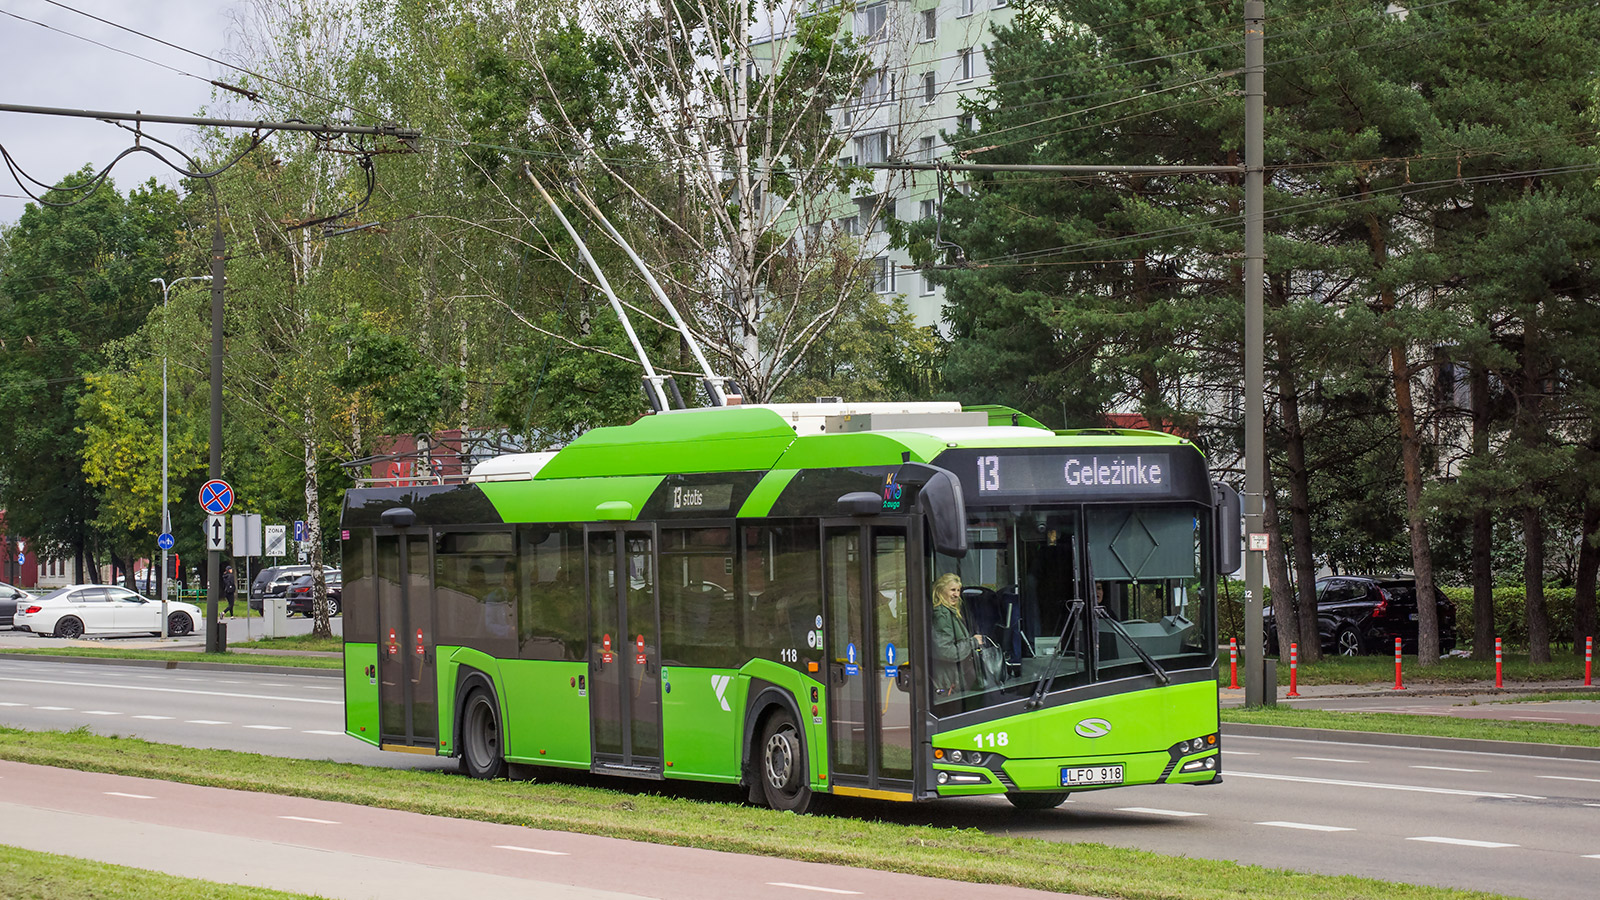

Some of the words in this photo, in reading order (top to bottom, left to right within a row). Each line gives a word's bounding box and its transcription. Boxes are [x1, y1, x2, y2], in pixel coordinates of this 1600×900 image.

[977, 455, 1000, 491] 13
[1064, 457, 1162, 486] Geležinke
[673, 486, 682, 508] 13
[296, 523, 301, 540] P
[780, 648, 798, 663] 118
[973, 731, 1009, 749] 118
[1068, 769, 1093, 782] LFO
[1101, 767, 1122, 780] 918
